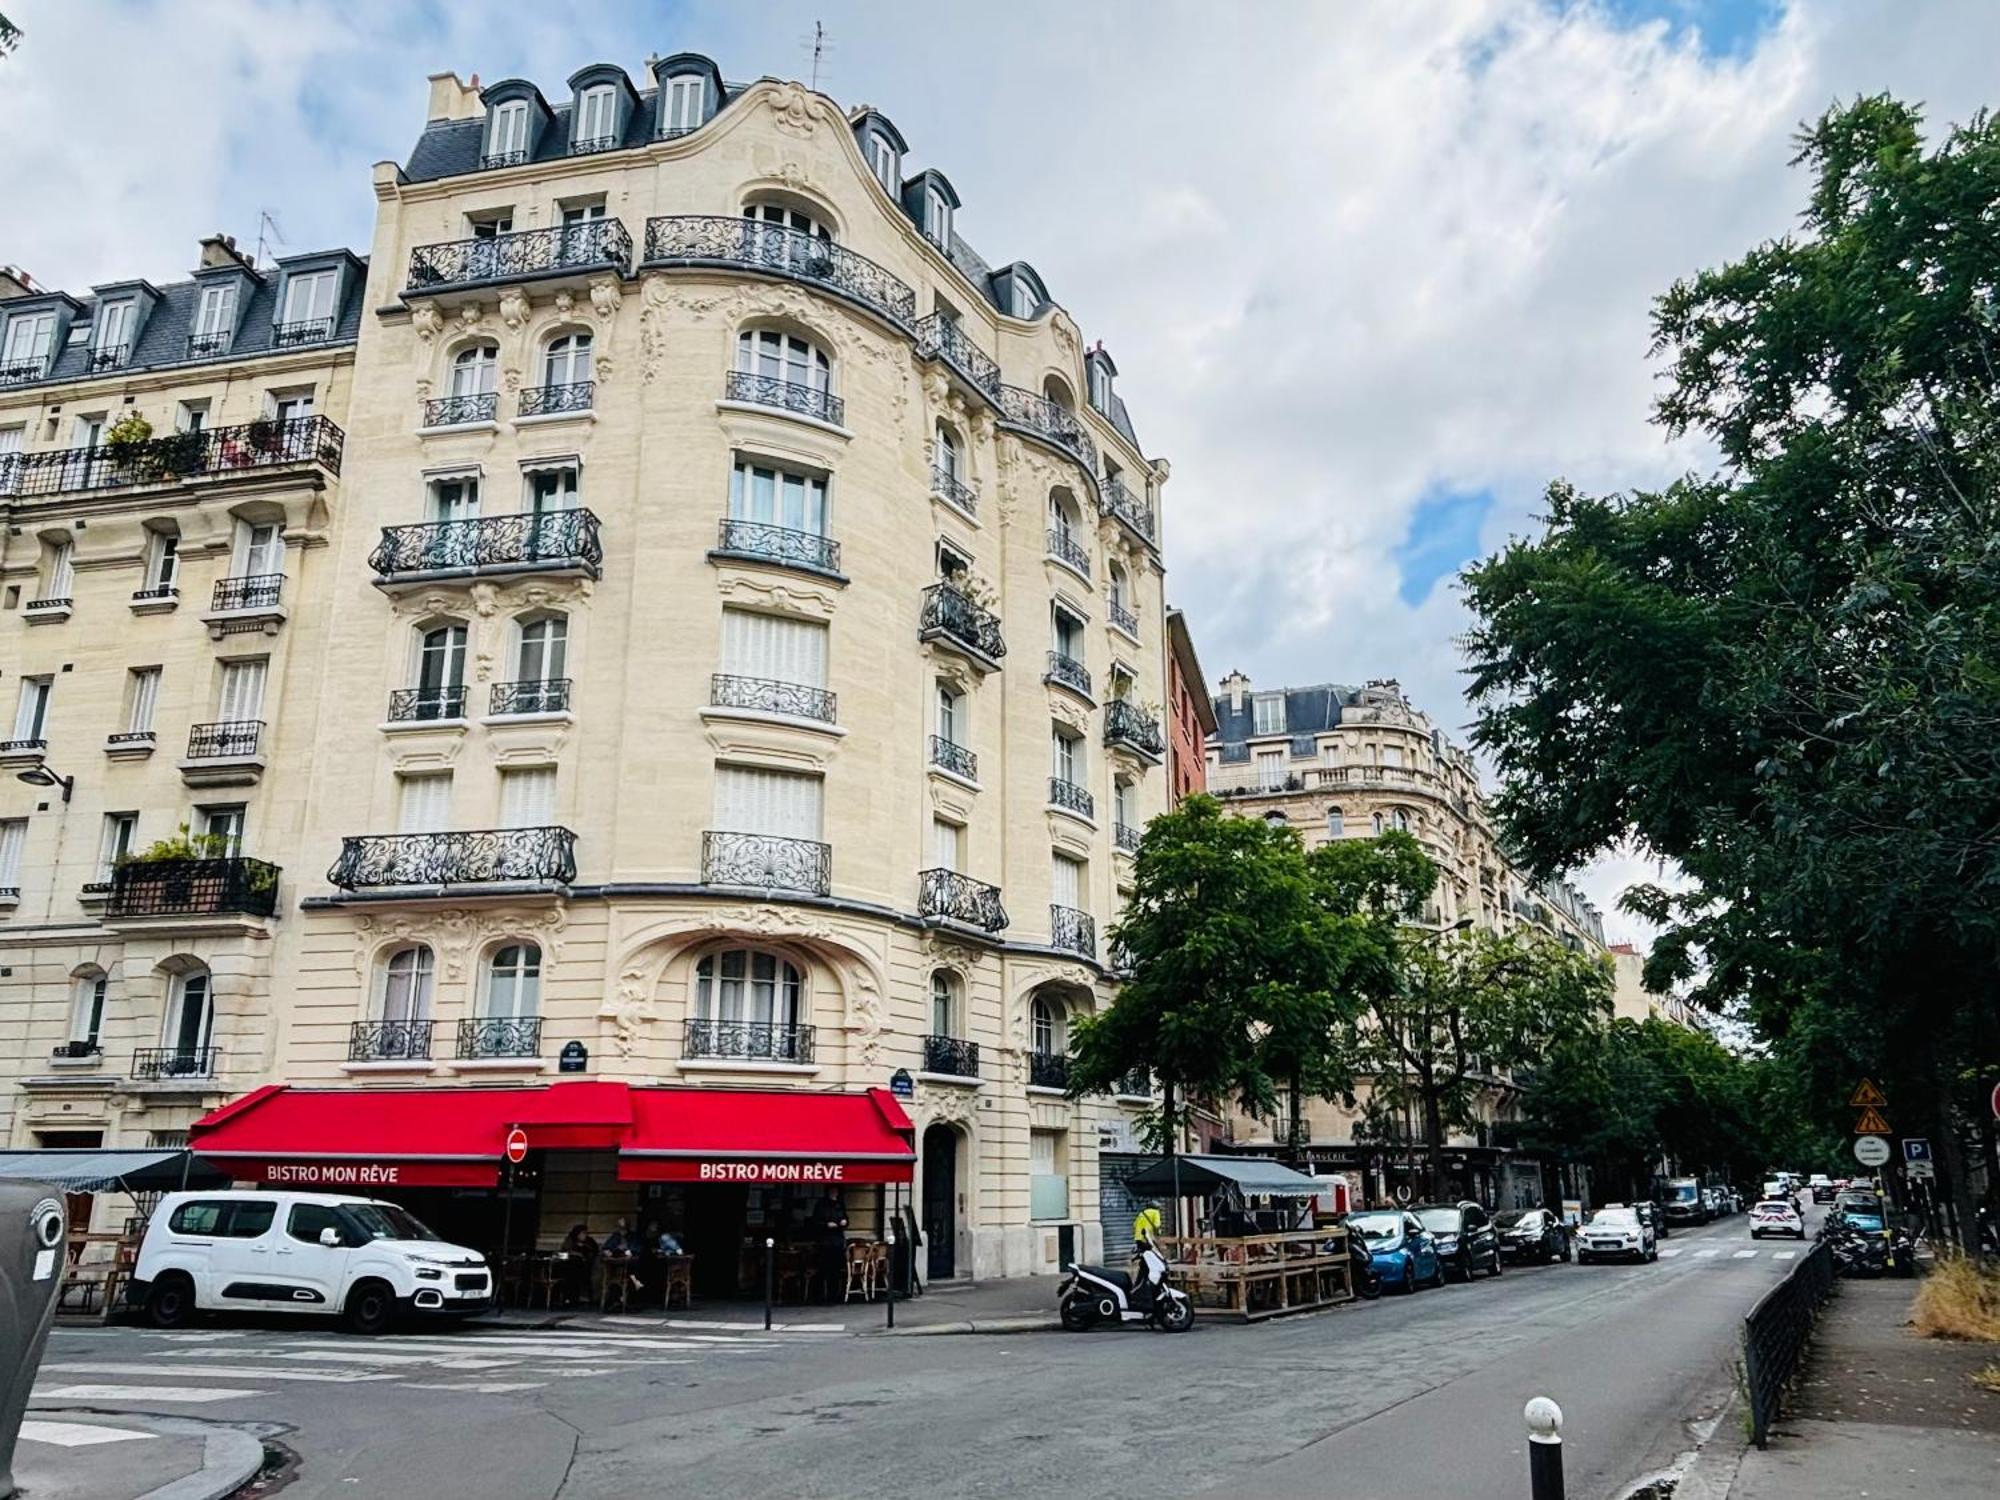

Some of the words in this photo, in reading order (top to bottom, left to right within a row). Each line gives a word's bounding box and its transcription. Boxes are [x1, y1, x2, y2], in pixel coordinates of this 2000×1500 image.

[1911, 1143, 1922, 1157] P
[267, 1165, 319, 1181] BISTRO
[322, 1166, 357, 1181] MON
[360, 1164, 399, 1183] RÊVE
[700, 1163, 759, 1179] BISTRO
[762, 1164, 800, 1180] MON
[803, 1162, 844, 1180] RÊVE
